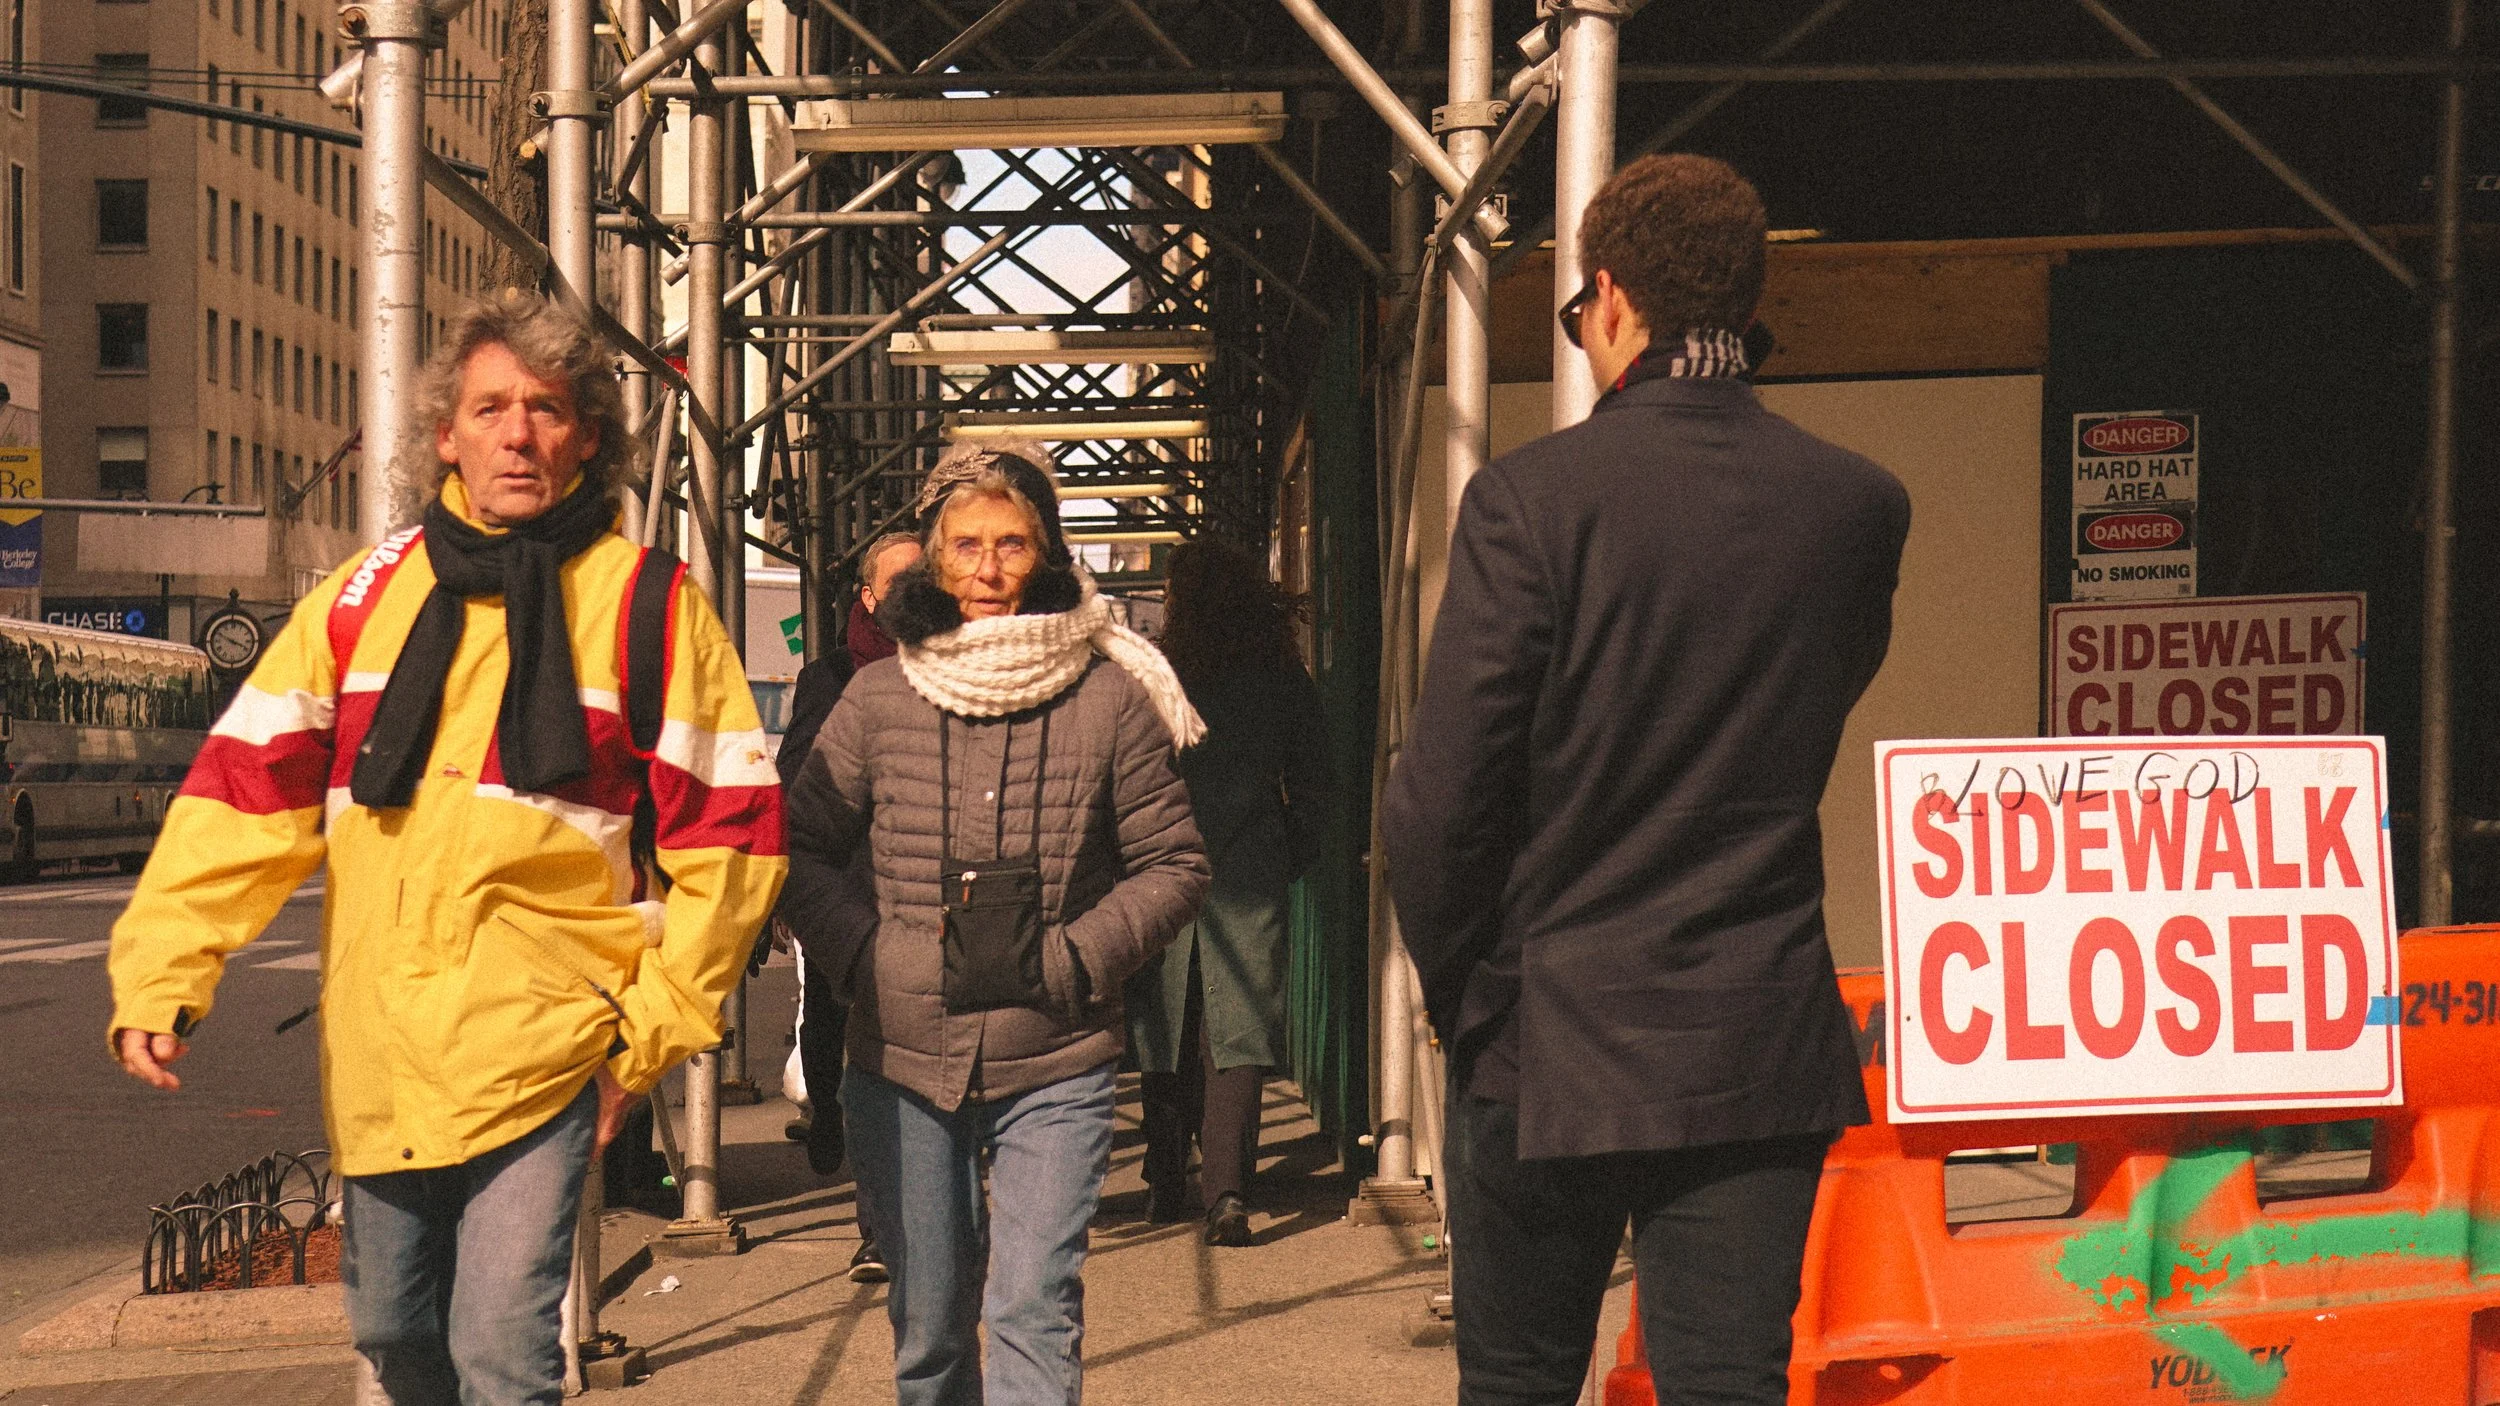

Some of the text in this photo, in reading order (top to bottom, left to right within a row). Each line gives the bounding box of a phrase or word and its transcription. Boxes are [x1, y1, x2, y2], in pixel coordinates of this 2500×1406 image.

[2092, 425, 2180, 446] DANGER
[2077, 458, 2194, 481] HARD HAT
[2104, 482, 2167, 501] AREA
[2093, 523, 2174, 542] DANGER
[2077, 564, 2190, 583] NO SMOKING
[47, 611, 123, 631] CHASE
[2067, 615, 2347, 674] SIDEWALK
[2067, 674, 2345, 737] CLOSED
[2135, 751, 2260, 805] GOD
[1911, 786, 2364, 899] SIDEWALK
[1919, 914, 2369, 1065] CLOSED
